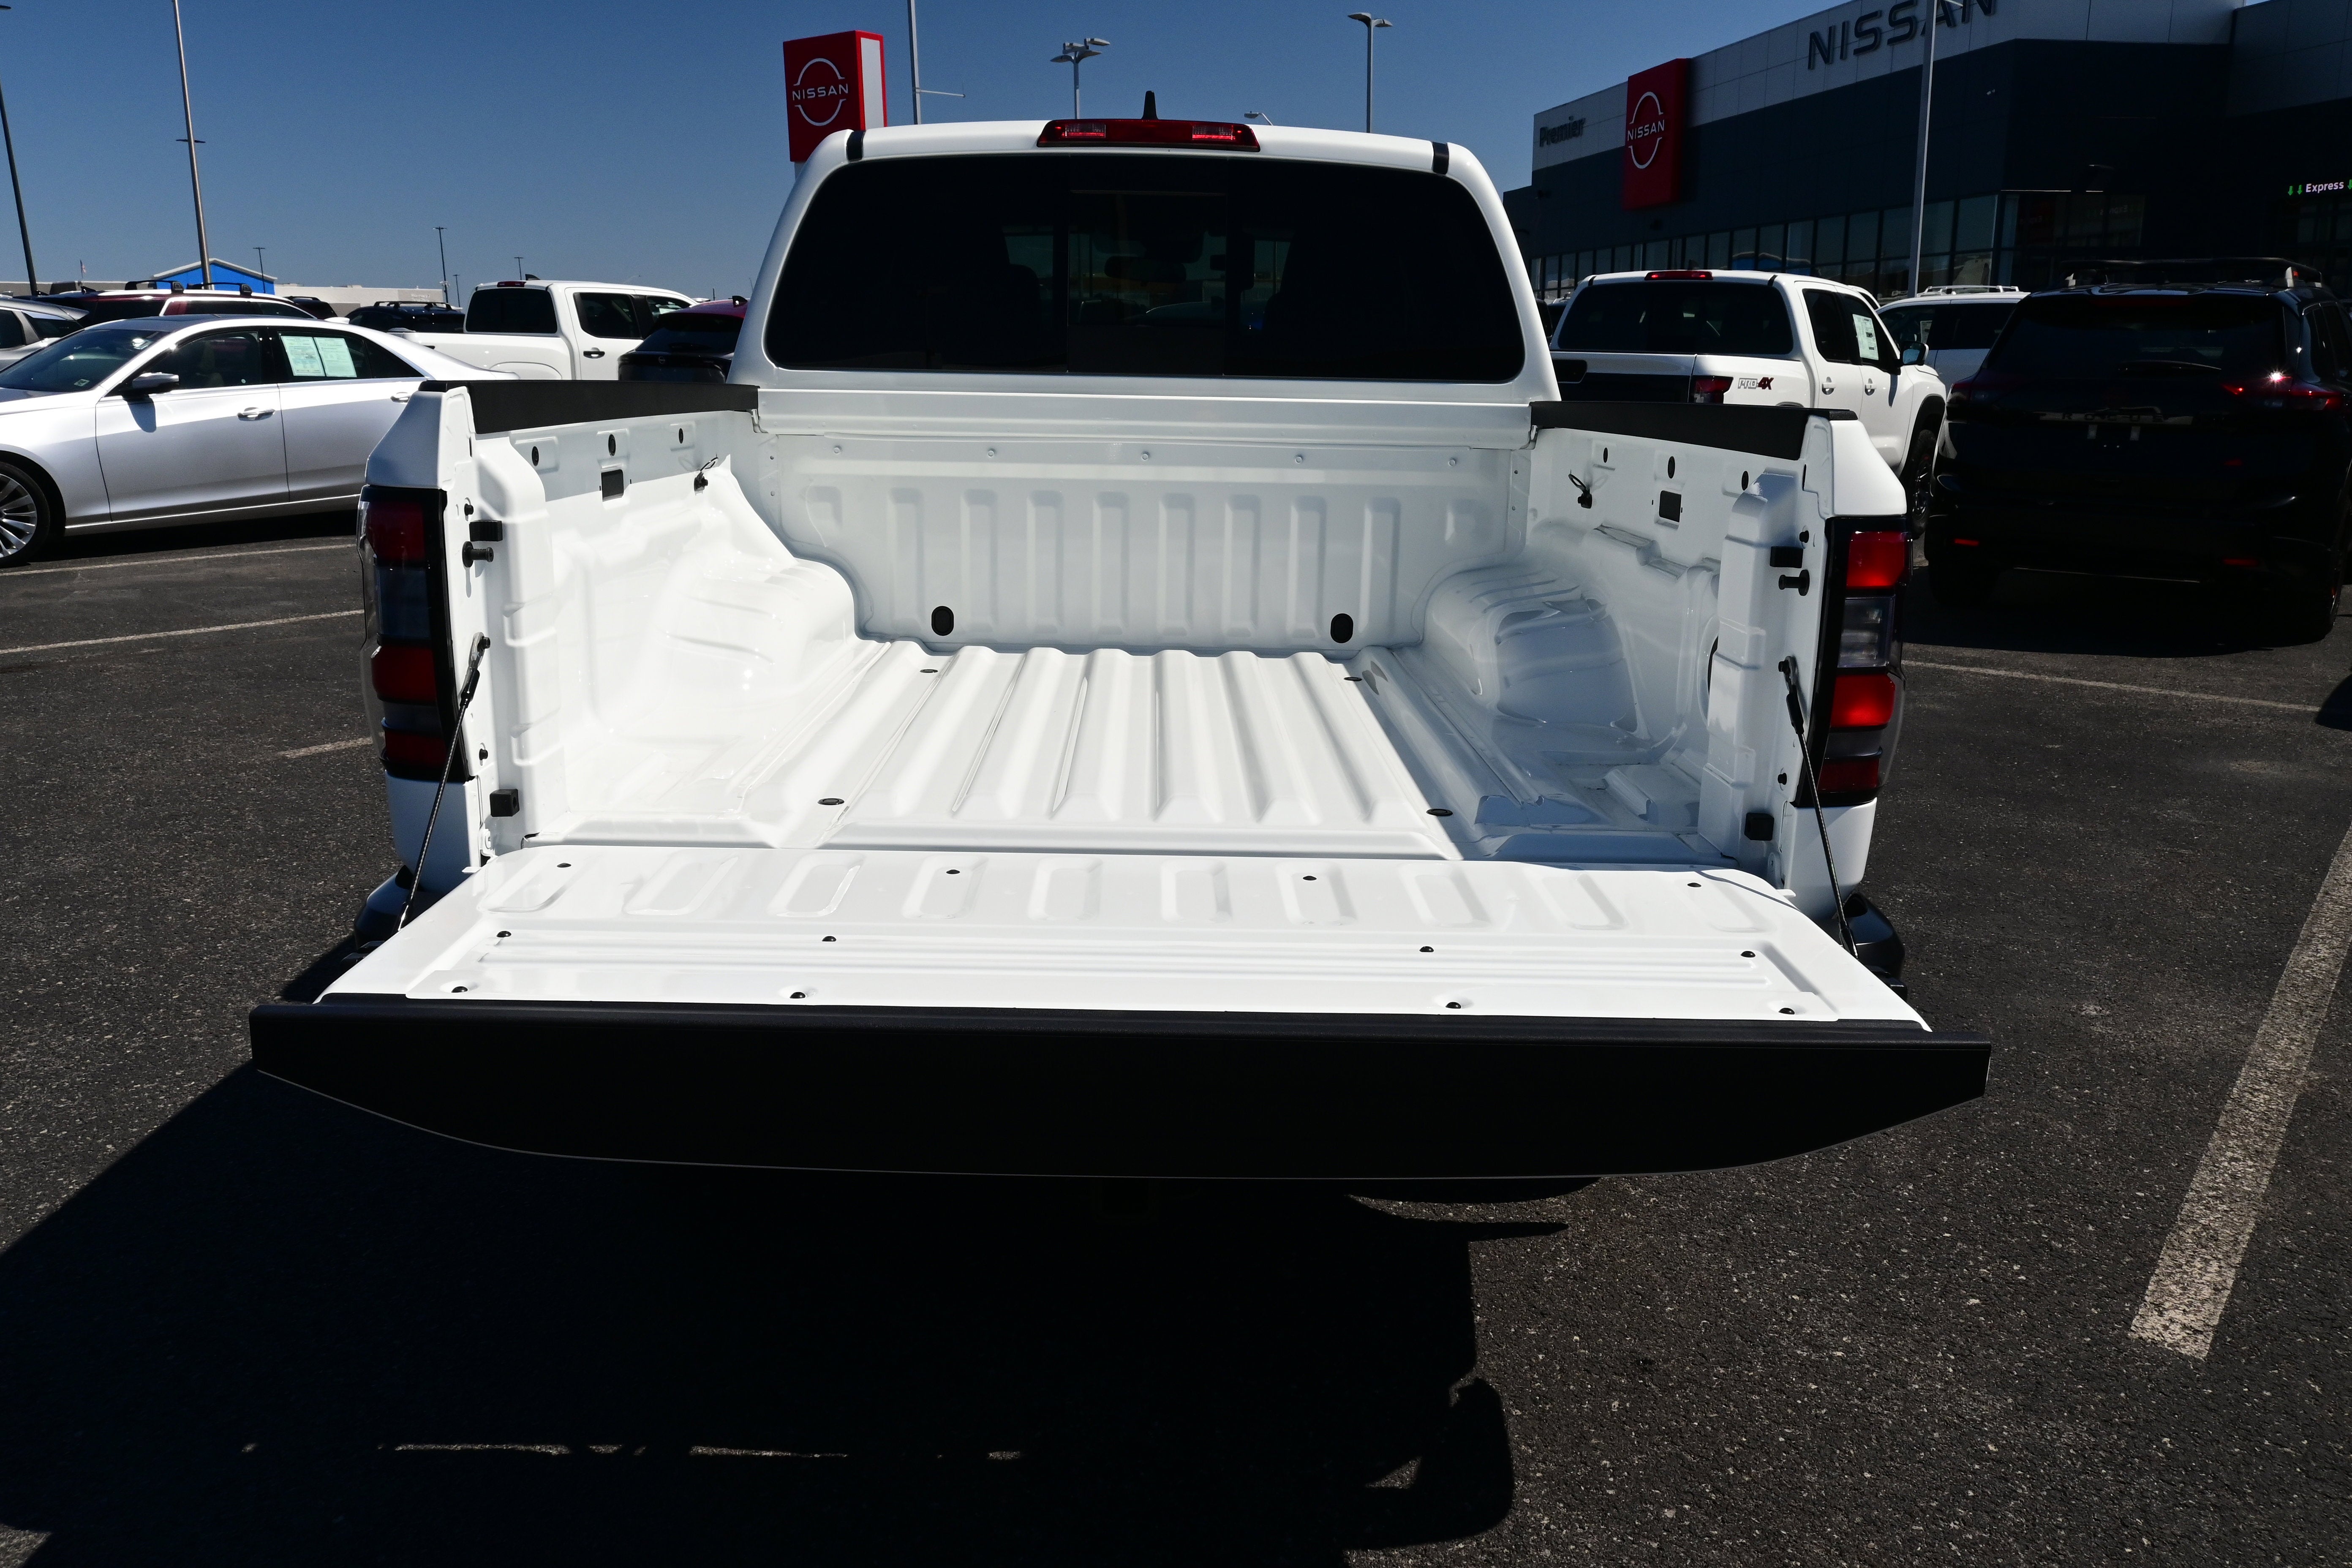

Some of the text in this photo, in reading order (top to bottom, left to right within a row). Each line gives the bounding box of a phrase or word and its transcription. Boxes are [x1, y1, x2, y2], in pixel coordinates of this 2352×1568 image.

[792, 83, 849, 101] NISSAN
[1539, 115, 1585, 147] Premier
[1627, 119, 1665, 142] NISSAN
[2306, 182, 2344, 193] Express
